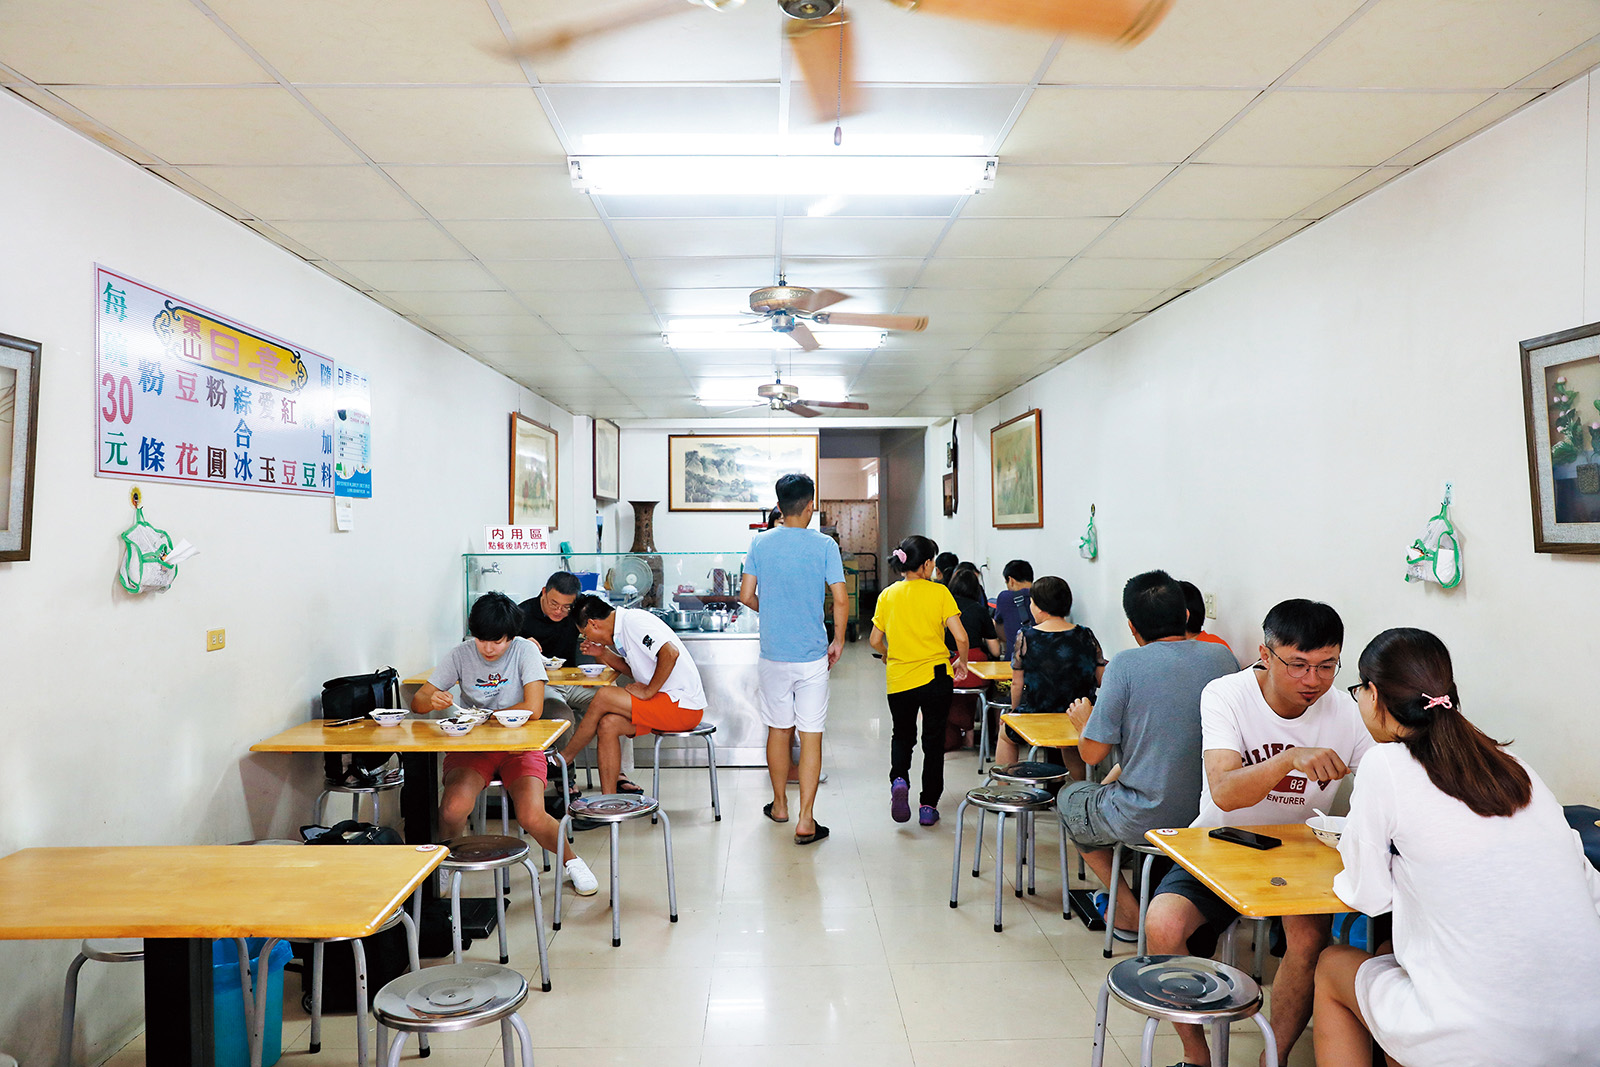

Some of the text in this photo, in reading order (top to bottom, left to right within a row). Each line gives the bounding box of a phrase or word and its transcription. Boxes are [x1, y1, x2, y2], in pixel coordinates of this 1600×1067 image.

[182, 313, 201, 361] 東山
[138, 358, 165, 472] 粉條
[175, 368, 199, 476] 豆花
[206, 375, 228, 480] 粉圓
[233, 384, 253, 482] 綜合冰
[258, 390, 276, 484] 愛玉
[280, 396, 298, 487] 紅豆
[1242, 743, 1296, 768] ALIF
[1266, 794, 1306, 806] ENTURER
[1289, 779, 1304, 790] 82
